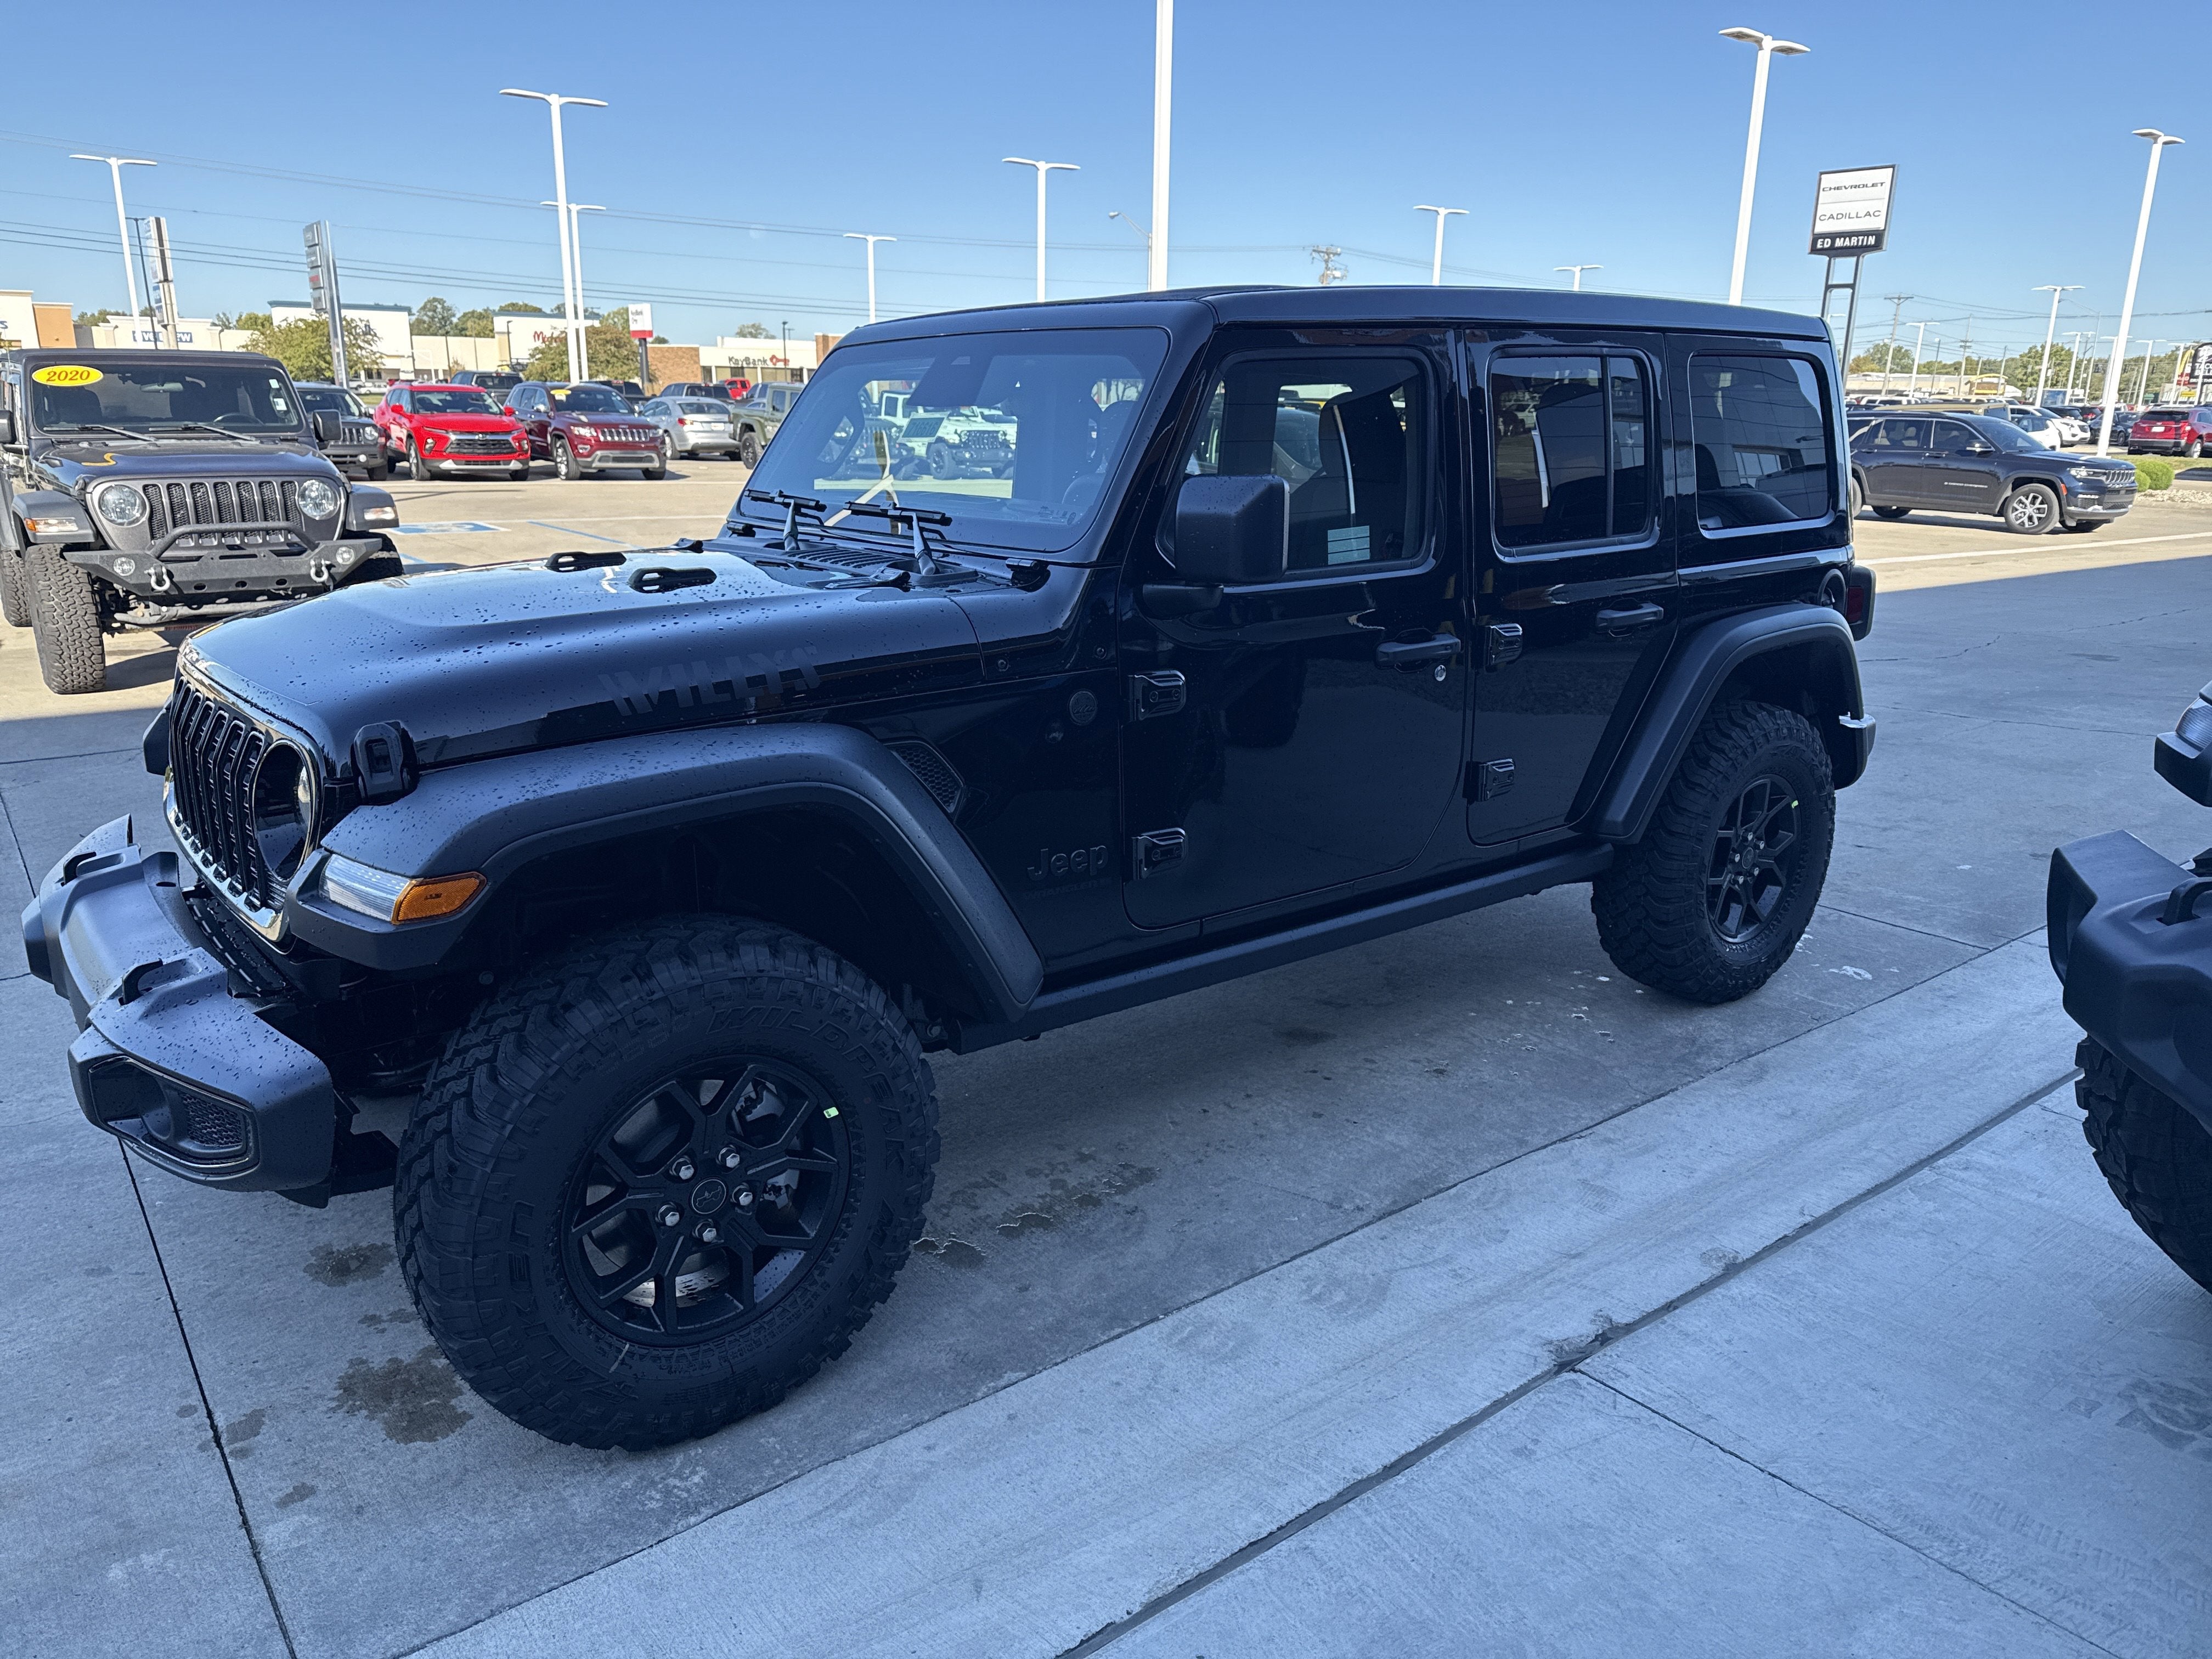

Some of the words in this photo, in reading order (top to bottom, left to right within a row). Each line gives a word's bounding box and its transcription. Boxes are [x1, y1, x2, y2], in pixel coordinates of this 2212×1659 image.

[1822, 182, 1886, 192] CHEVROLET
[1819, 210, 1882, 222] CADILLAC
[1816, 238, 1831, 249] ED
[1835, 235, 1876, 247] MARTIN
[728, 356, 769, 366] KeyBank
[46, 370, 91, 382] 2020
[597, 645, 822, 716] WILLYS
[1027, 845, 1109, 881] Jeep
[706, 1006, 906, 1171] WILDPEAK
